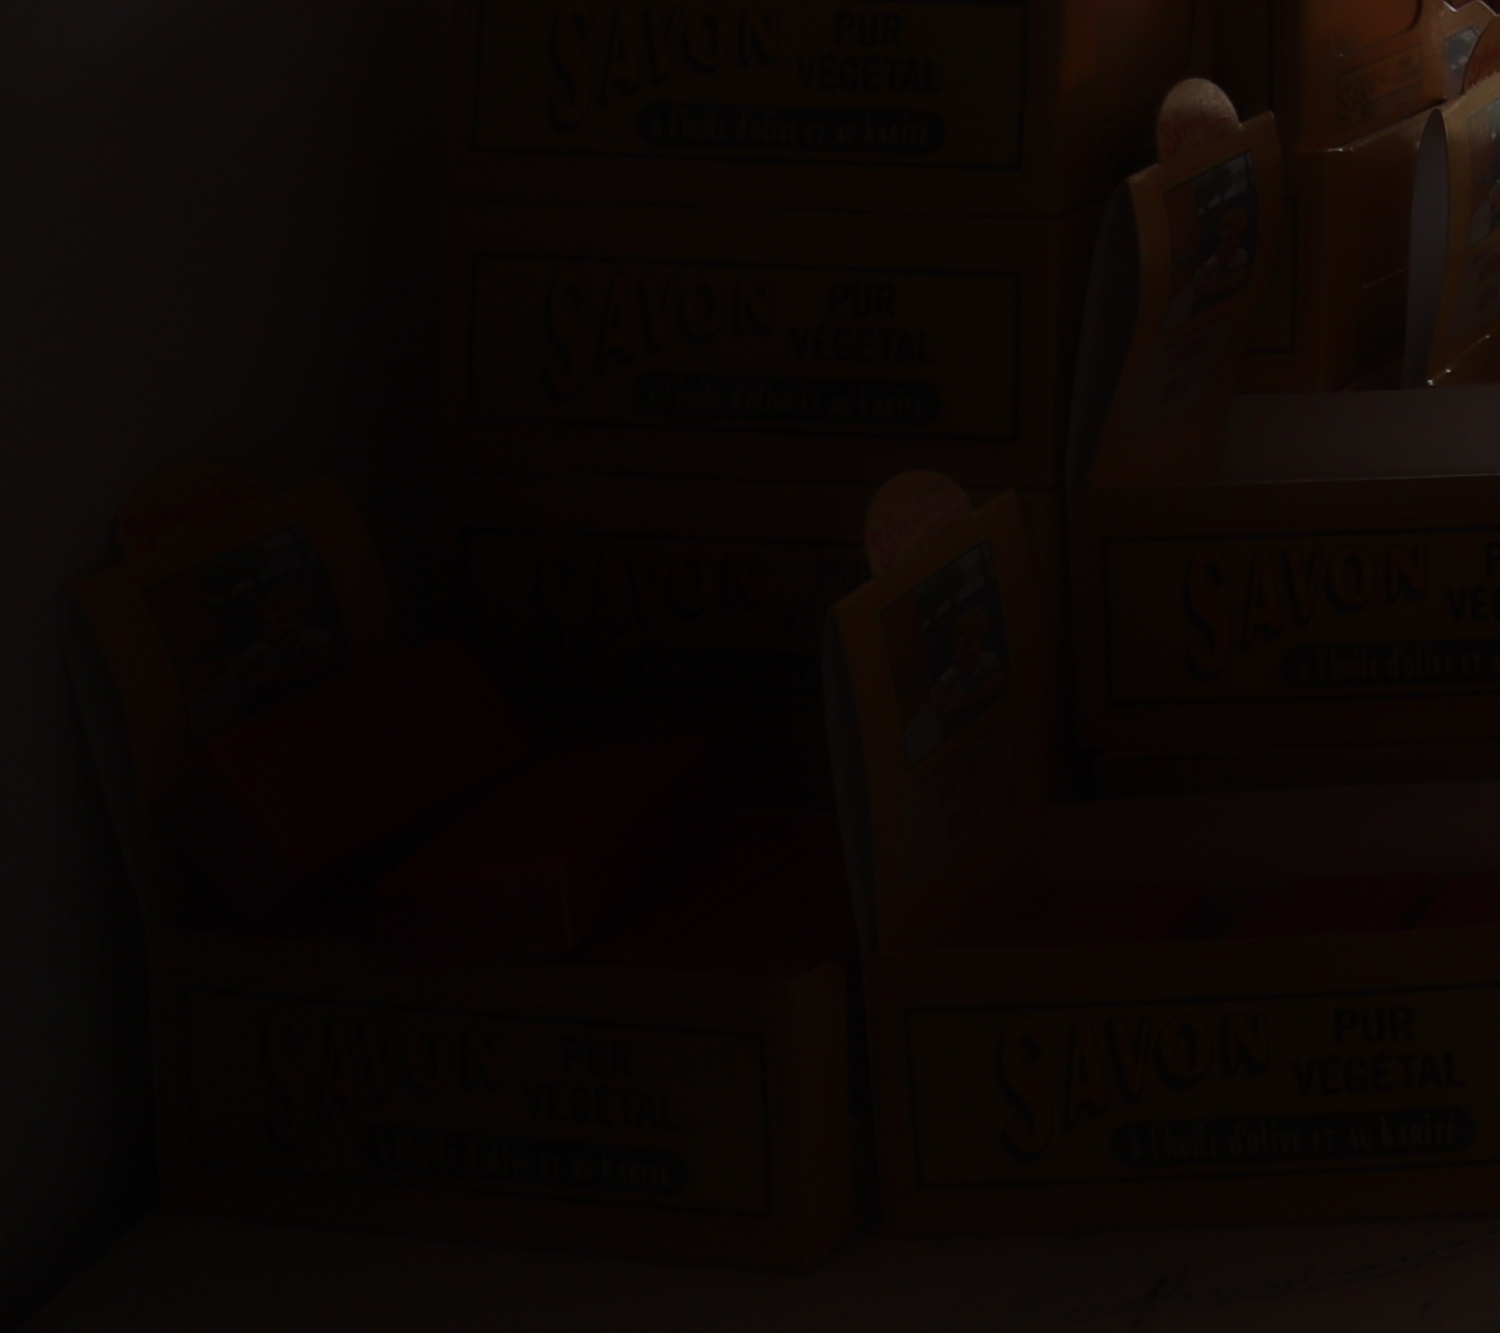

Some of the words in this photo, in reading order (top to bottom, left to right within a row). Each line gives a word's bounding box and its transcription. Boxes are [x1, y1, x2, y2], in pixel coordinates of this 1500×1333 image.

[833, 11, 904, 49] PUR
[796, 51, 942, 94] VÉGÉTAL
[827, 281, 897, 318] PUR
[540, 266, 776, 402] SAVON
[789, 321, 937, 365] VÉGÉTAL
[1183, 540, 1429, 684] SAVON
[1333, 1004, 1415, 1045] PUR
[260, 1002, 504, 1153] SAVON
[560, 1037, 634, 1079] PUR
[1291, 1045, 1467, 1096] VÉGÉTAL
[523, 1076, 679, 1131] VÉGÉTAL
[994, 1010, 1270, 1163] SAVON
